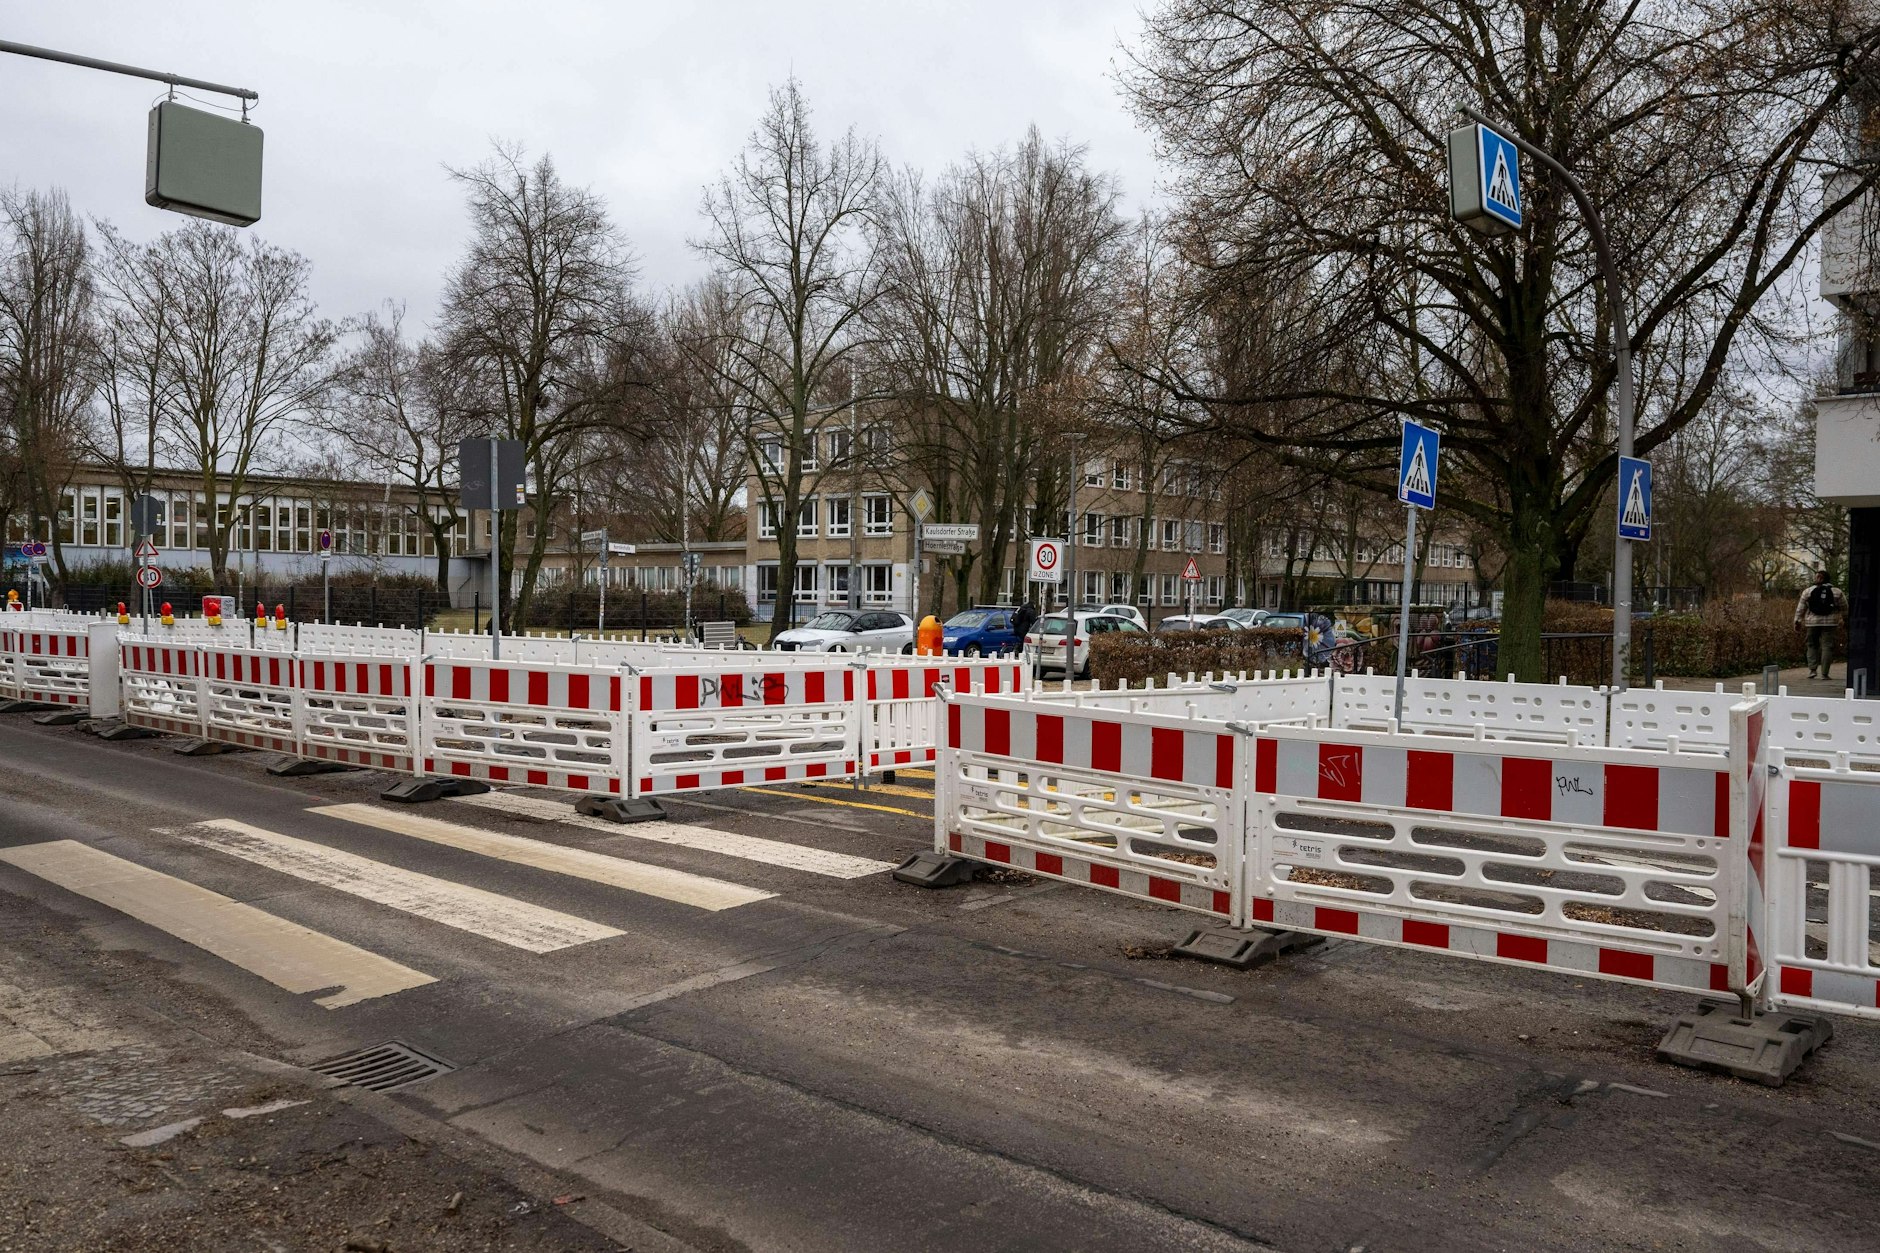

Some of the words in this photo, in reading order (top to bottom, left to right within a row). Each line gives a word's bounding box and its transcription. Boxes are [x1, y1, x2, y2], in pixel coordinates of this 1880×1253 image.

[925, 526, 956, 536] Kaulsdorfer
[957, 527, 976, 538] Straße
[1040, 550, 1053, 563] 30
[1038, 570, 1054, 579] ZONE
[1299, 844, 1322, 854] tetris
